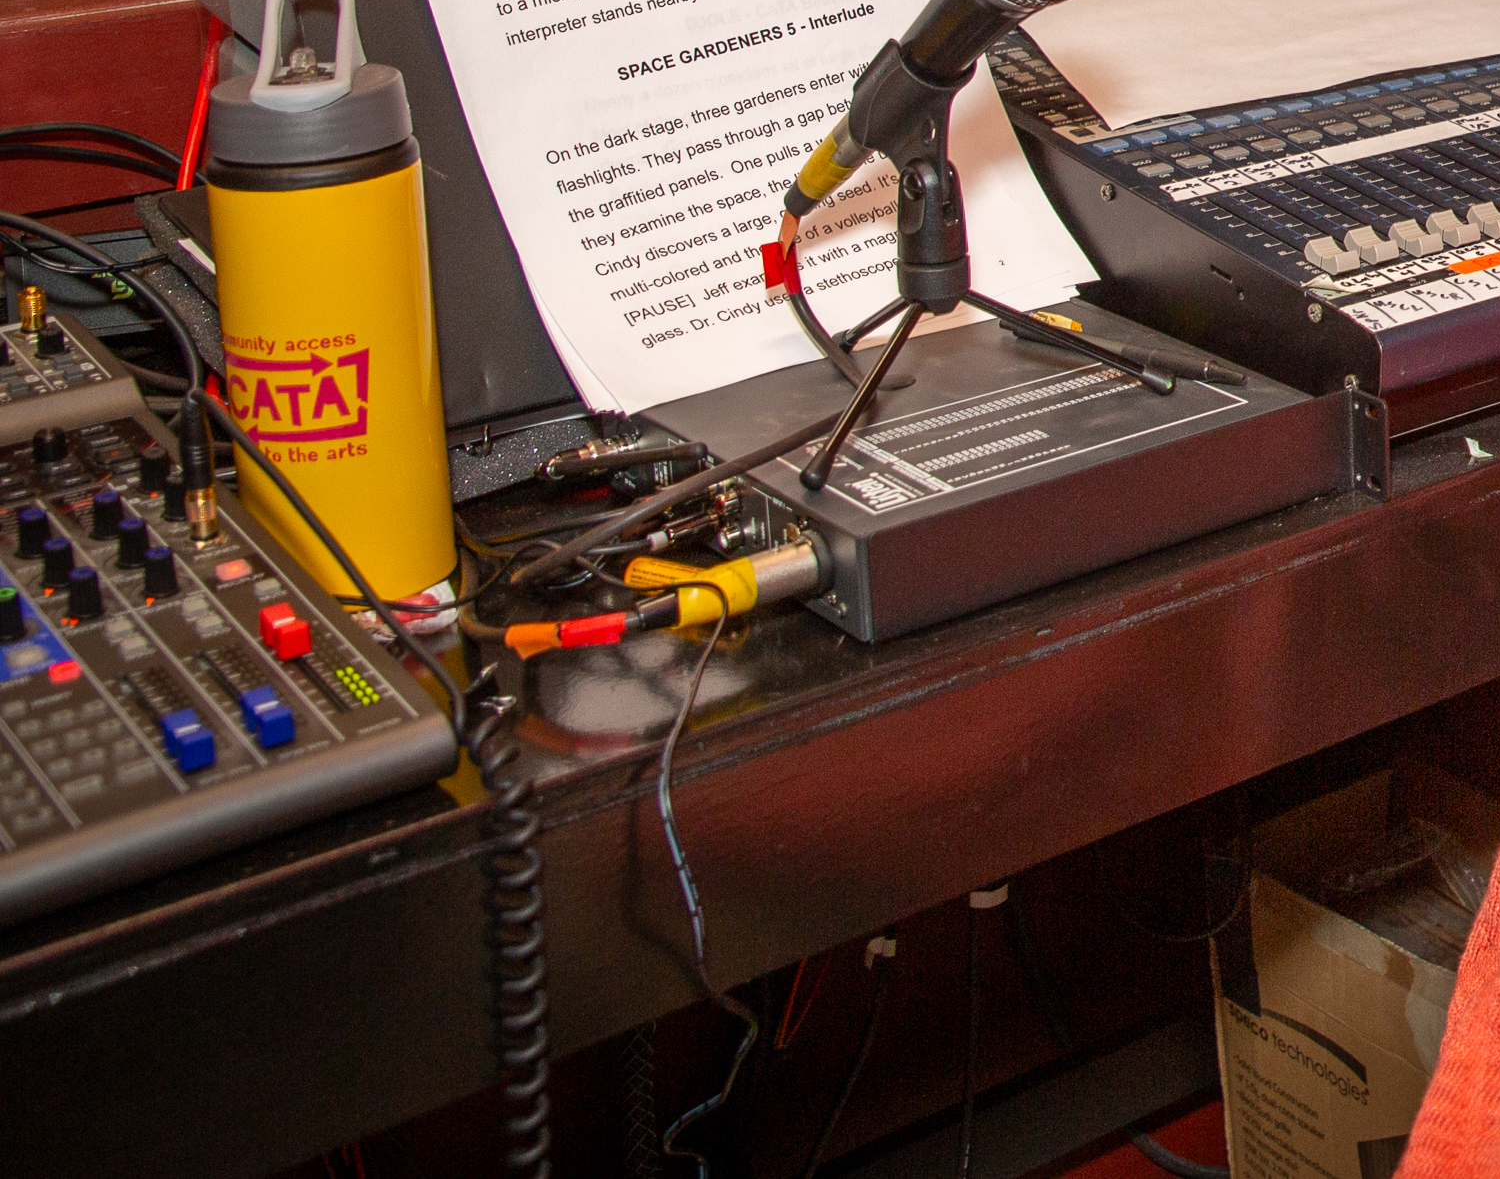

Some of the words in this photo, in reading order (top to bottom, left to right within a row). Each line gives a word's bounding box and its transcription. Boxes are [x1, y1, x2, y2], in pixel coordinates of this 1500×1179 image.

[496, 3, 512, 16] to
[518, 0, 528, 11] a
[506, 16, 587, 46] interpreter
[592, 2, 643, 24] stands
[618, 54, 676, 80] SPACE
[679, 26, 783, 64] GARDENERS
[787, 22, 796, 35] 5
[808, 4, 874, 30] Interlude
[546, 150, 571, 164] On
[574, 142, 600, 157] the
[604, 129, 639, 148] dark
[642, 118, 688, 138] stage,
[691, 105, 730, 124] three
[734, 84, 806, 115] gardeners
[810, 72, 844, 90] enter
[556, 163, 640, 194] flashlights.
[642, 150, 681, 168] They
[686, 139, 722, 160] pass
[724, 120, 781, 145] through
[784, 118, 794, 128] a
[798, 109, 824, 127] gap
[568, 208, 594, 222] the
[599, 183, 665, 217] graffitied
[668, 170, 723, 196] panels.
[731, 158, 763, 173] One
[766, 146, 800, 166] pulls
[803, 143, 813, 152] a
[581, 232, 615, 250] they
[620, 212, 685, 238] examine
[688, 204, 713, 218] the
[716, 189, 766, 210] space,
[768, 179, 792, 194] the
[595, 255, 640, 276] Cindy
[645, 232, 718, 261] discovers
[721, 228, 732, 238] a
[733, 216, 777, 233] large,
[836, 181, 877, 200] seed.
[877, 173, 900, 191] It's
[610, 261, 710, 301] multi-colored
[713, 251, 742, 269] and
[805, 225, 819, 239] of
[822, 225, 833, 234] a
[834, 200, 898, 230] volleyball
[624, 294, 696, 326] [PAUSE]
[704, 282, 743, 300] Jeff
[804, 256, 818, 268] it
[818, 247, 849, 265] with
[851, 244, 862, 252] a
[642, 328, 688, 348] glass.
[690, 318, 714, 330] Dr.
[717, 302, 760, 321] Cindy
[804, 286, 814, 294] a
[816, 258, 898, 290] stethoscope
[285, 333, 356, 351] access
[228, 375, 351, 426] CATA
[288, 447, 319, 463] the
[327, 442, 369, 461] arts
